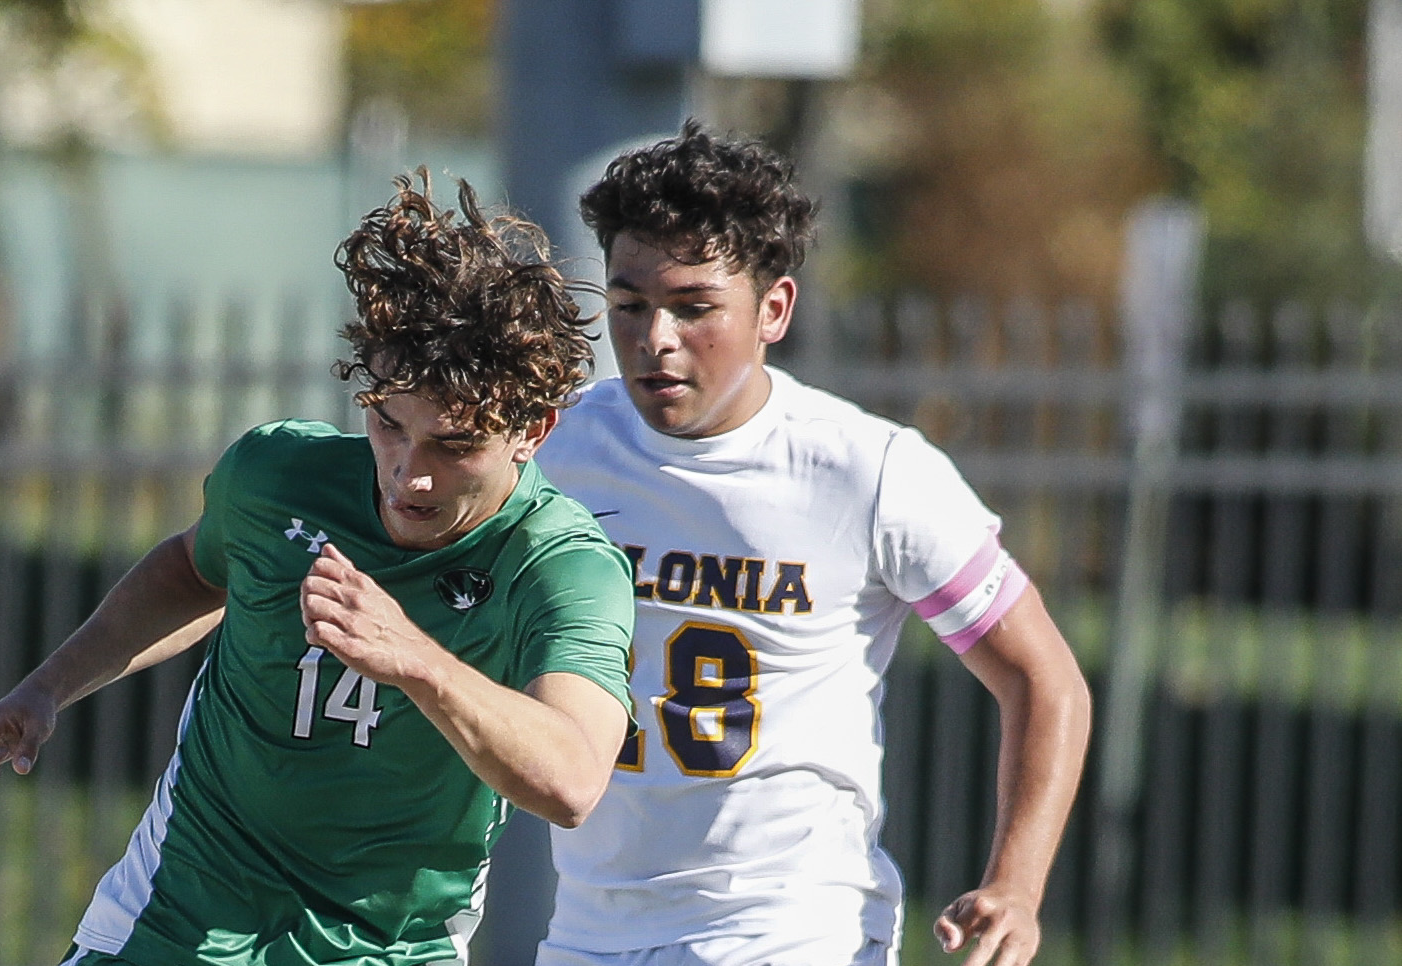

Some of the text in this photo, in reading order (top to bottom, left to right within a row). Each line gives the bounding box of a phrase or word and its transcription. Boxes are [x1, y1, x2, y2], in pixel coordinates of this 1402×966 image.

[620, 543, 814, 615] LONIA
[292, 645, 383, 748] 14
[615, 619, 762, 778] 8
